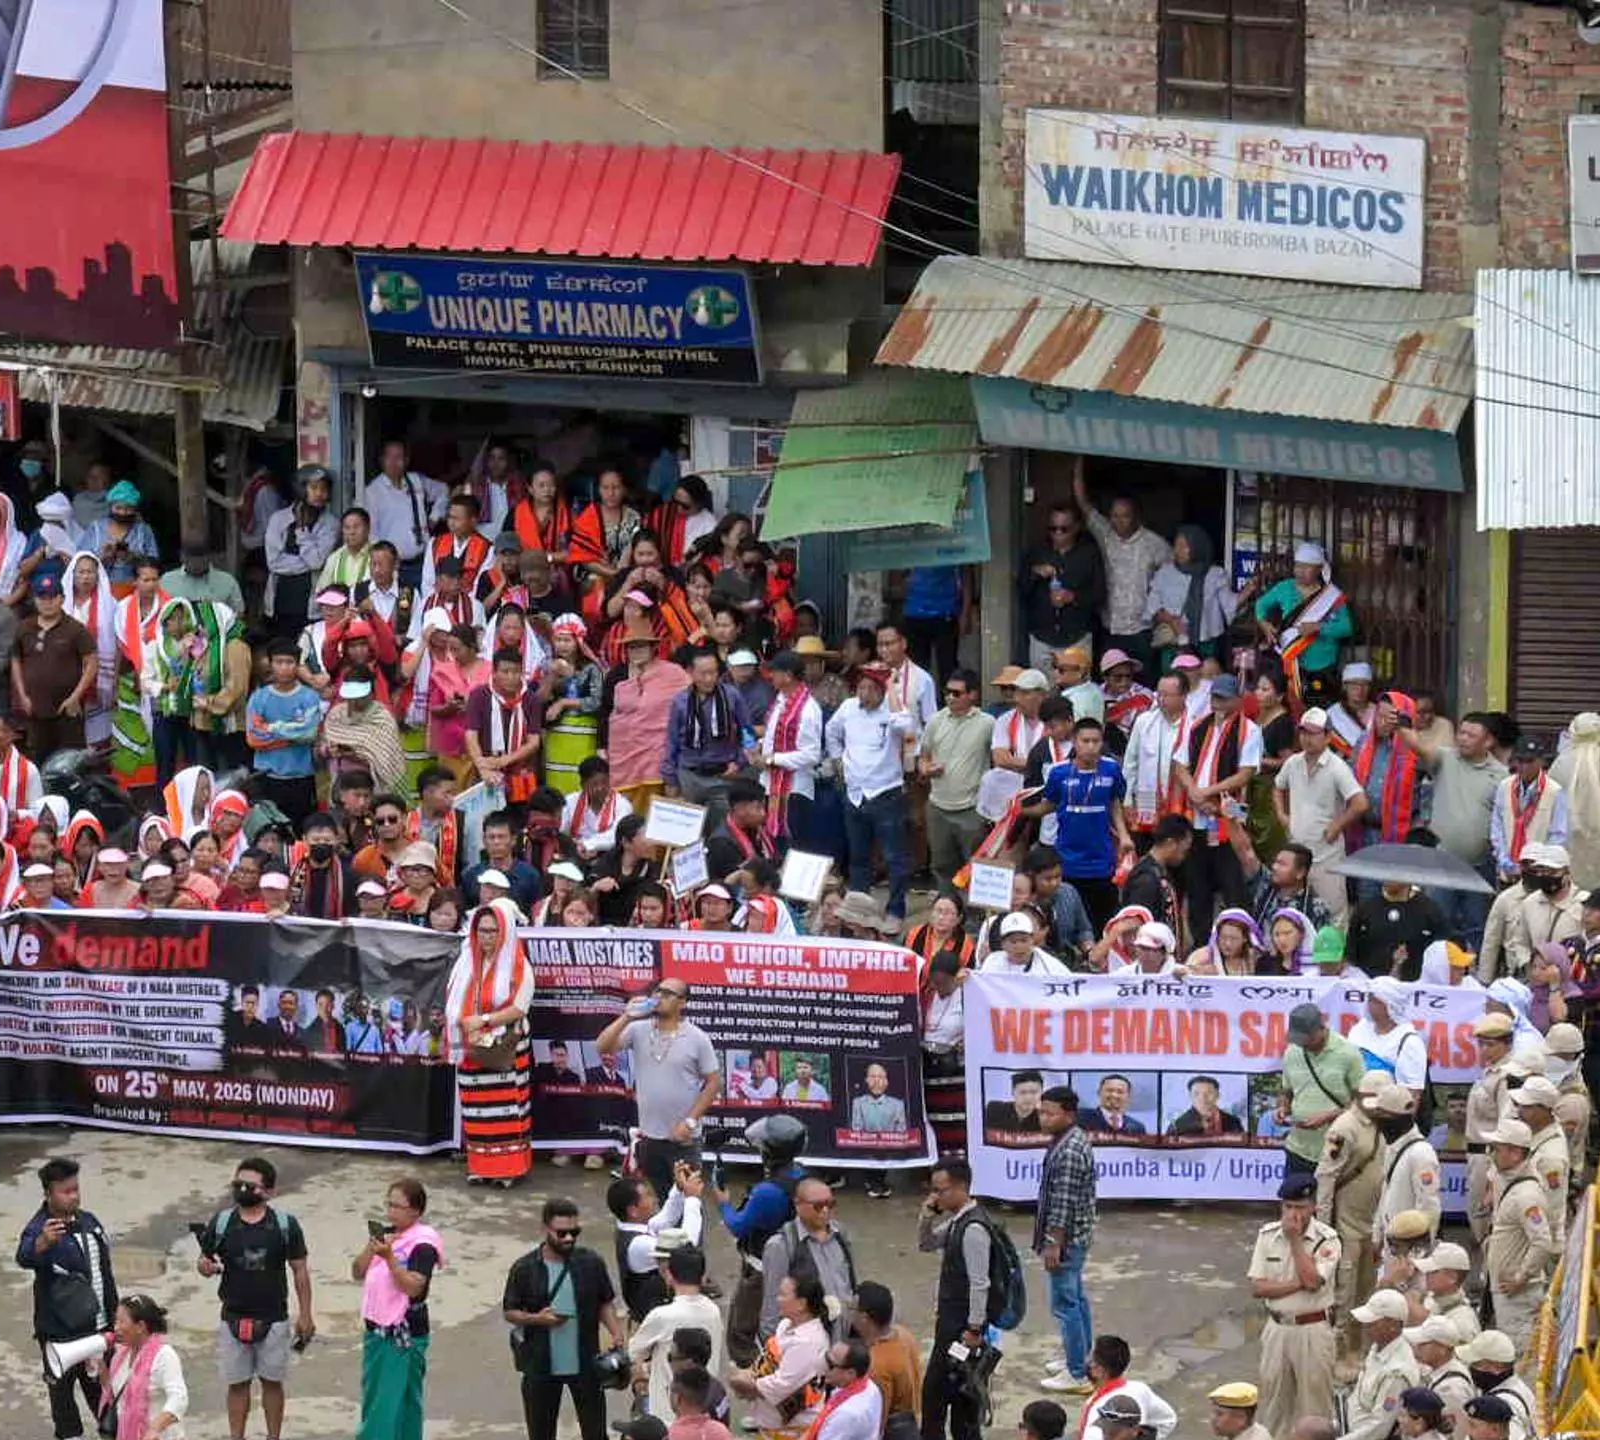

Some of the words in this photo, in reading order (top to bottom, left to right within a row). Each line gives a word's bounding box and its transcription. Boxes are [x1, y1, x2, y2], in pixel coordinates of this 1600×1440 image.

[1040, 163, 1222, 220] WAIKHOM
[1237, 179, 1406, 234] MEDICOS
[1071, 217, 1139, 240] PALACE
[1314, 237, 1373, 260] BAZAR
[427, 296, 532, 336] UNIQUE
[537, 299, 685, 342] PHARMACY
[406, 336, 470, 351] PALACE
[1005, 412, 1220, 459] WAIKHOM
[1235, 433, 1436, 483] MEDICOS
[53, 924, 209, 970] demand
[573, 940, 654, 967] HOSTAGES
[672, 942, 725, 965] MAO
[818, 948, 911, 973] IMPHAL
[724, 967, 760, 986] WE
[763, 969, 847, 990] DEMAND
[990, 1006, 1054, 1055] WE
[1062, 1006, 1229, 1057] DEMAND
[1239, 1010, 1308, 1060] SA
[95, 1075, 118, 1094] ON
[214, 1083, 251, 1102] 2026
[256, 1085, 335, 1112] (MONDAY)
[1096, 1159, 1160, 1185] punba
[1168, 1158, 1206, 1181] Lup
[1229, 1158, 1287, 1182] Uripo
